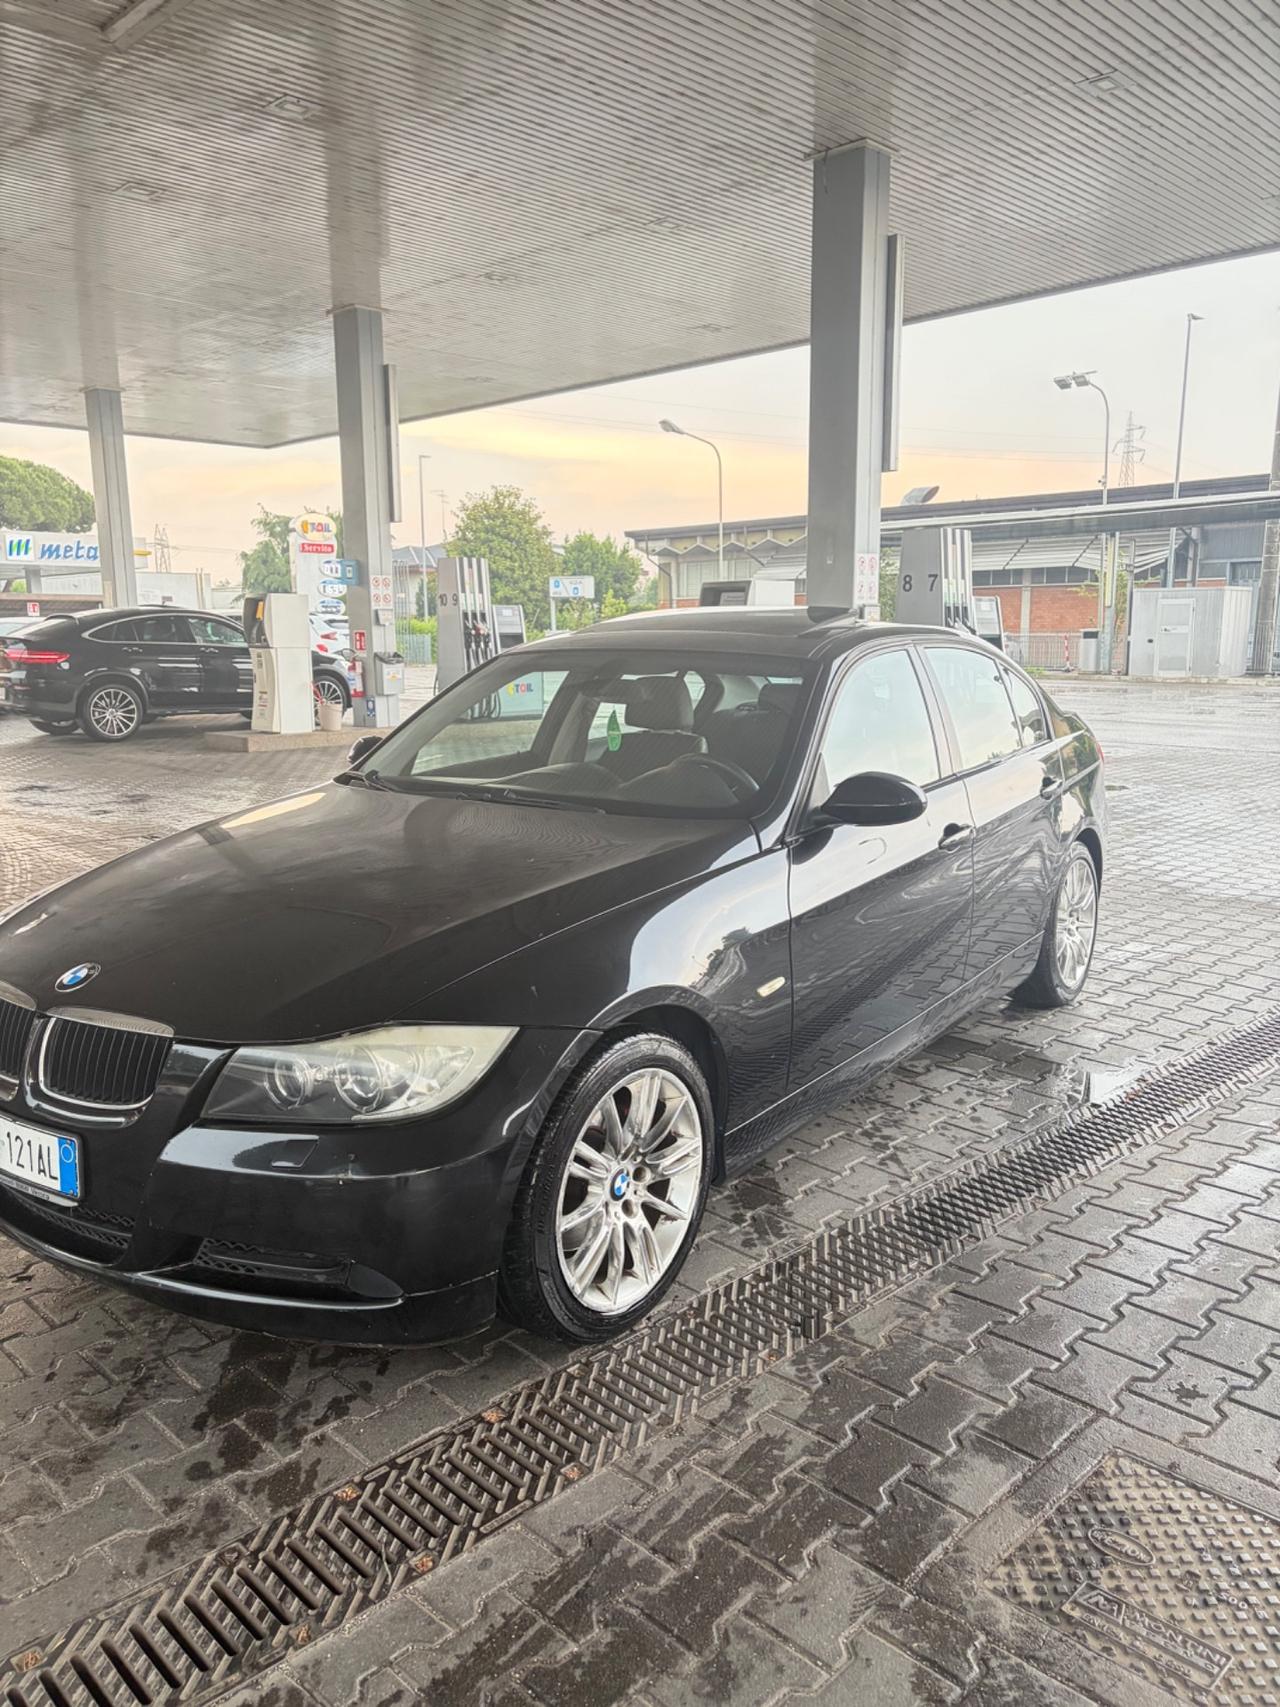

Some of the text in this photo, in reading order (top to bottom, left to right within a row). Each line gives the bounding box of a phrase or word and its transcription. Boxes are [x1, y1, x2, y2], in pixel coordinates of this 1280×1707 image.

[902, 573, 939, 593] 8 7
[438, 592, 459, 607] 10 9
[1129, 1609, 1227, 1665] MONTINI
